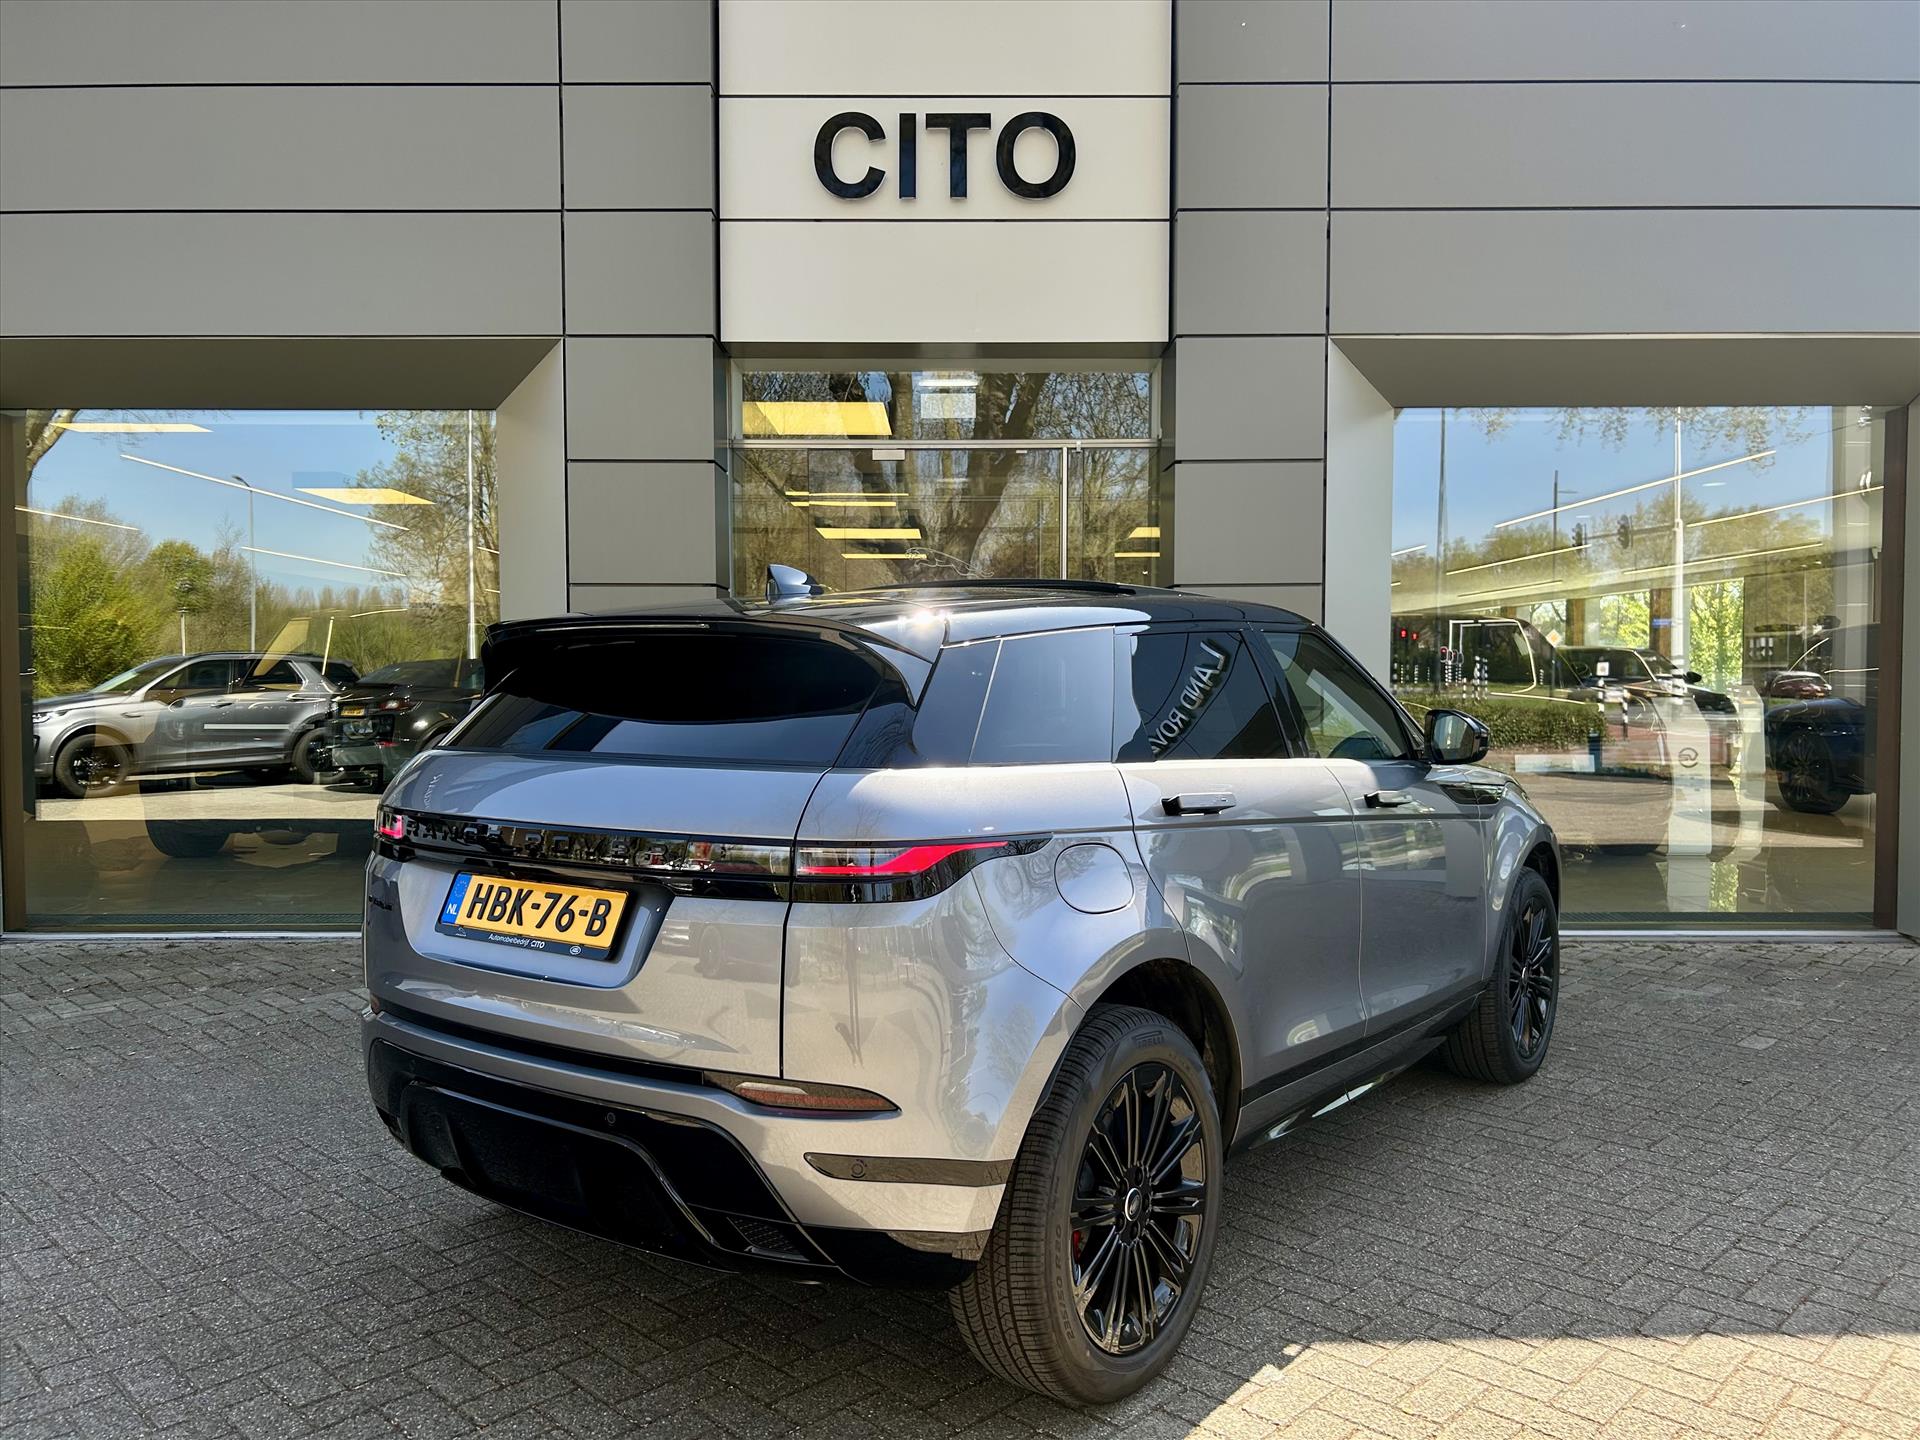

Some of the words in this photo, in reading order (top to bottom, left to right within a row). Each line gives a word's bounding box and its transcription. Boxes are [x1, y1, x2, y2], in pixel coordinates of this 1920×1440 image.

[814, 112, 1077, 199] CITO
[406, 817, 503, 847] RANGE
[525, 832, 669, 867] ROVER
[446, 903, 457, 915] NL
[466, 884, 612, 937] HBK-76-B
[530, 940, 546, 949] CITO
